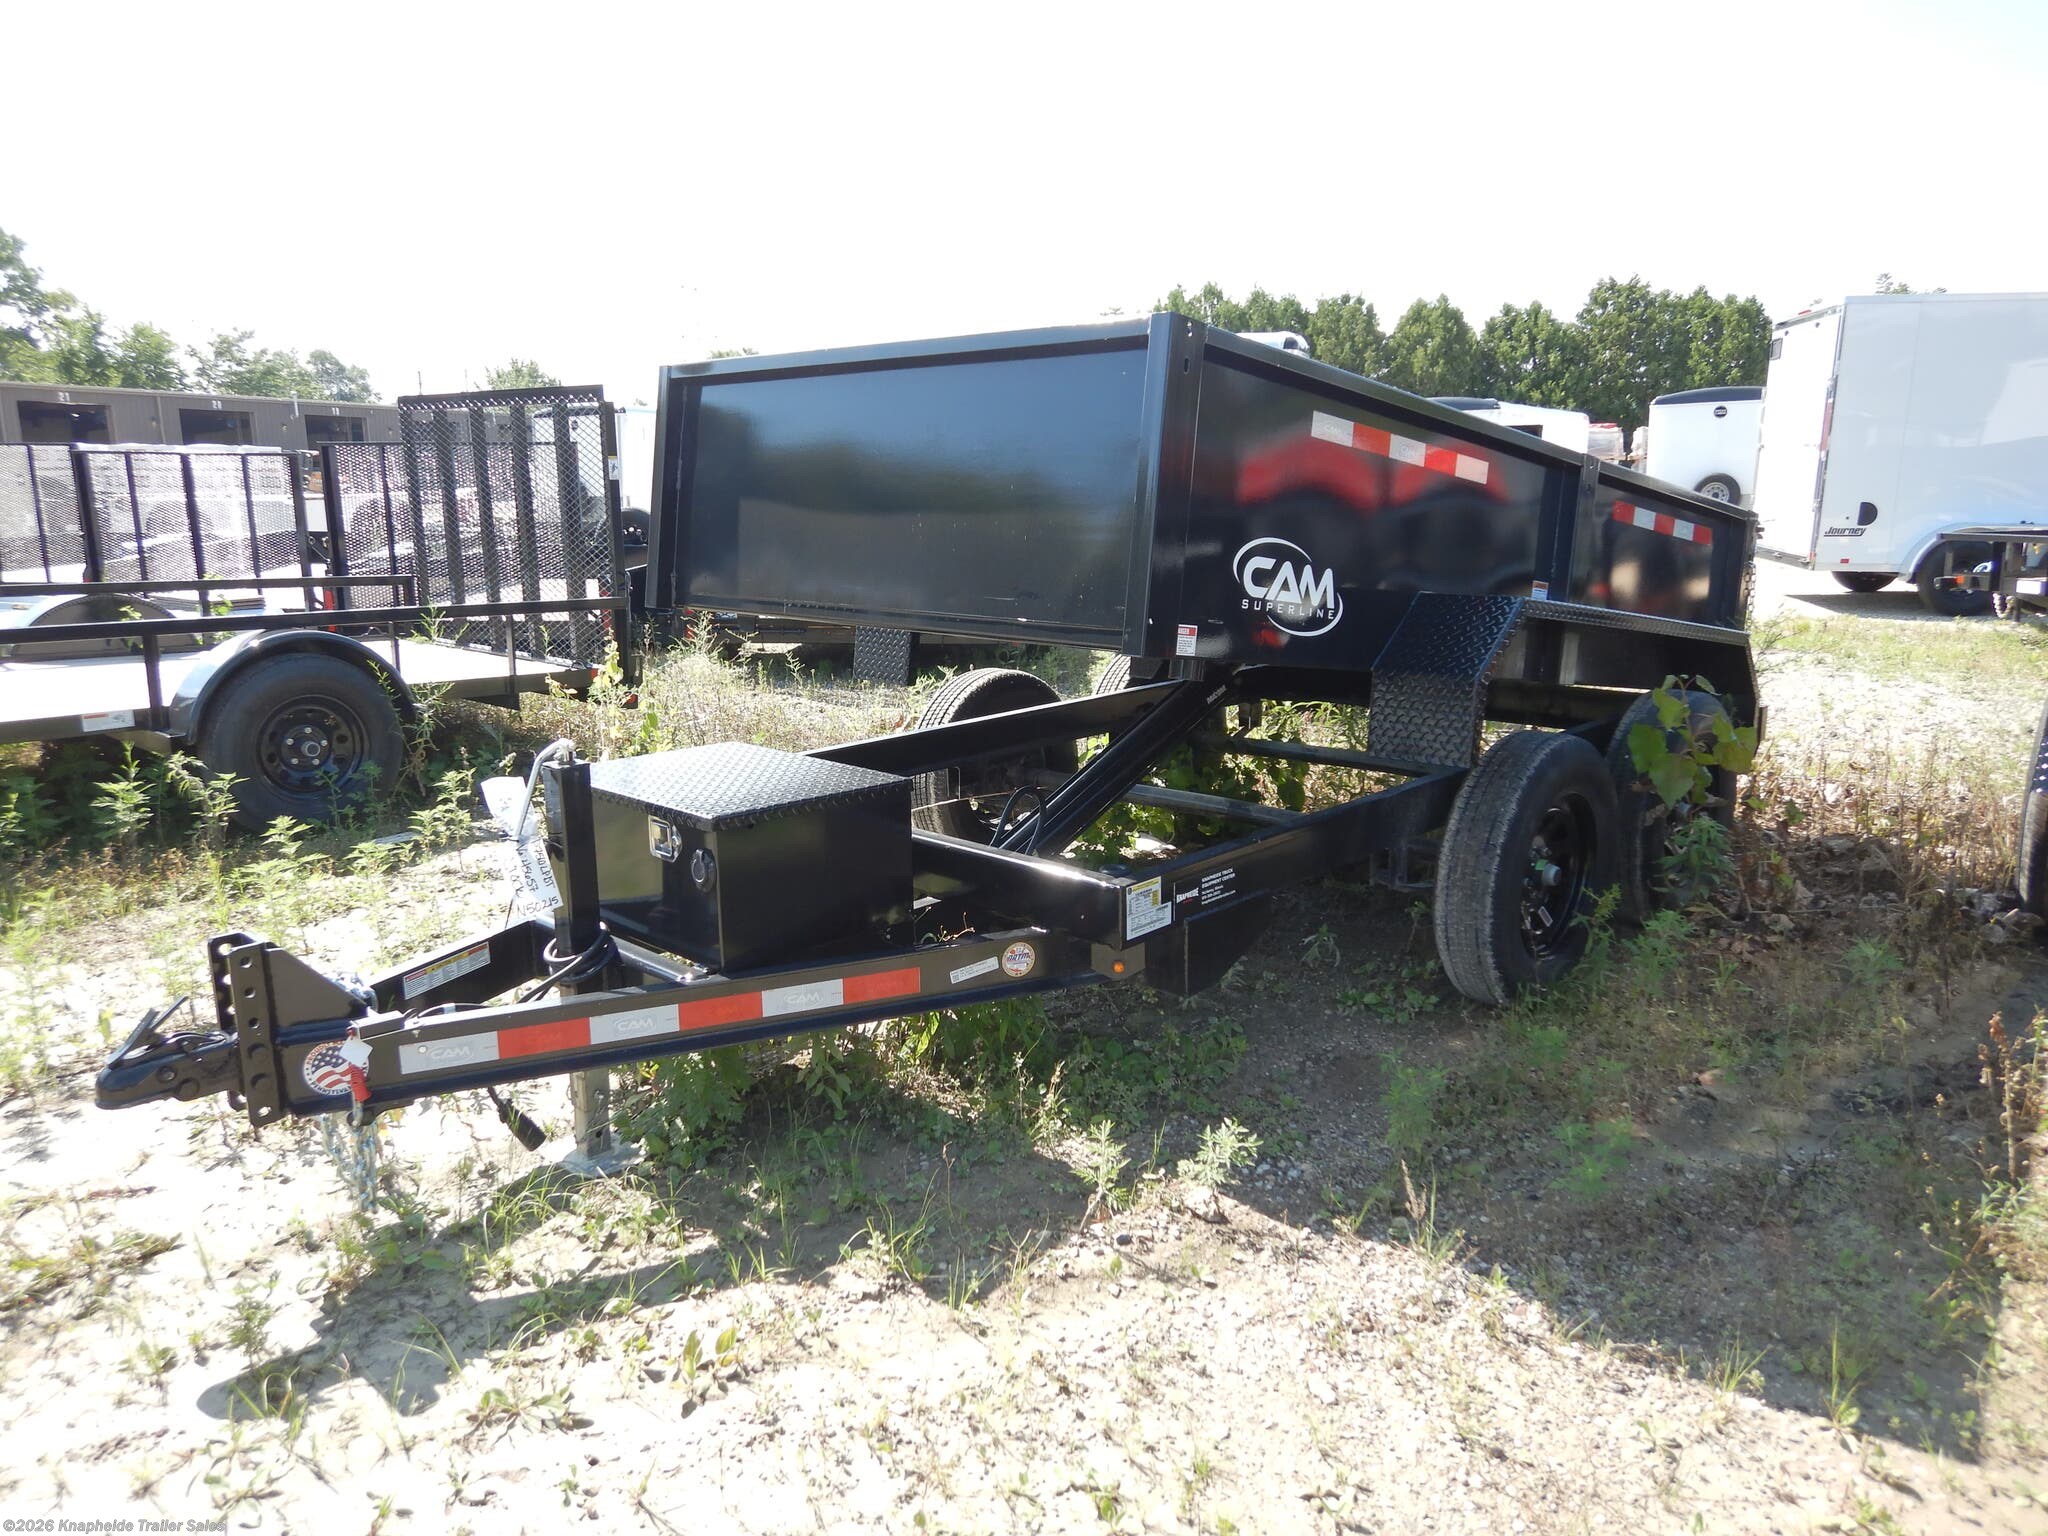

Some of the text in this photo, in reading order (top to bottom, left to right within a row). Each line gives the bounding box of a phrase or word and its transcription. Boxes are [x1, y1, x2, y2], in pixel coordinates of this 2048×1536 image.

[1824, 526, 1867, 537] Journey
[1243, 556, 1335, 609] CAM
[1241, 599, 1335, 620] SUPERLINE
[615, 1016, 655, 1031] CAM
